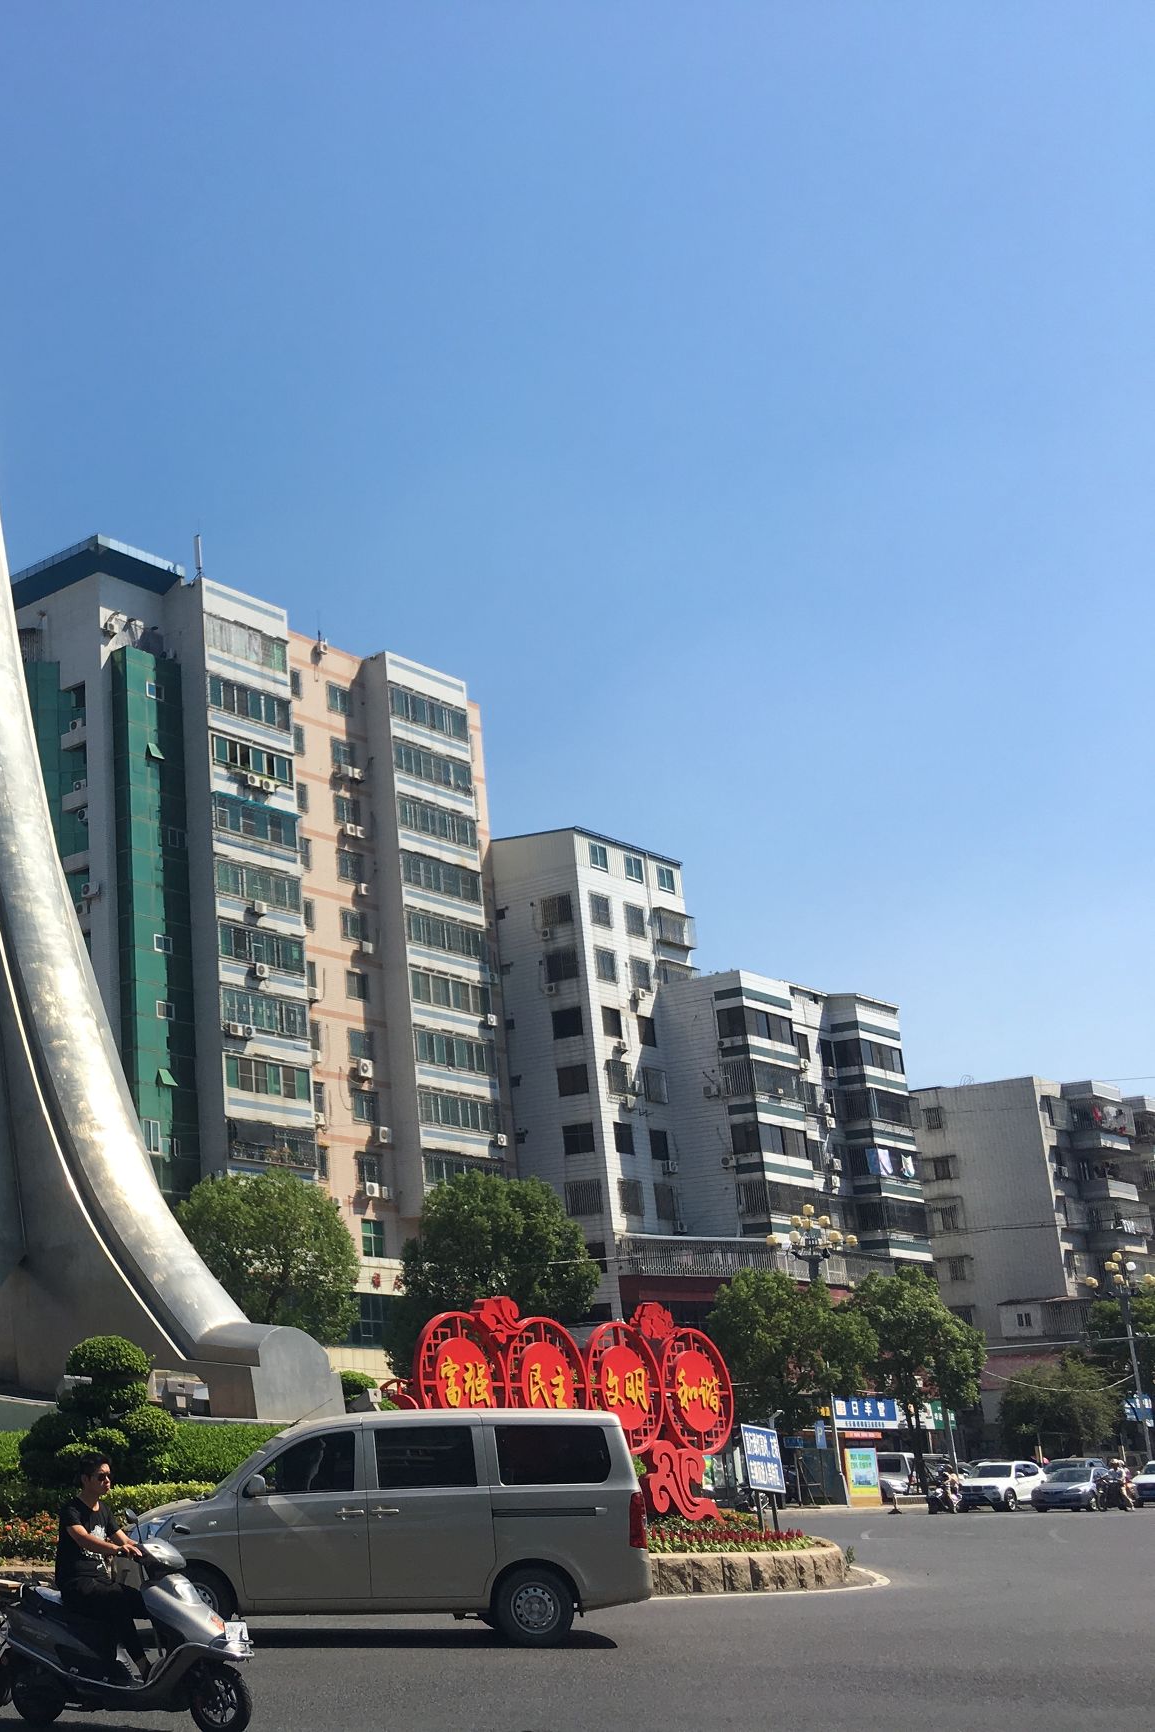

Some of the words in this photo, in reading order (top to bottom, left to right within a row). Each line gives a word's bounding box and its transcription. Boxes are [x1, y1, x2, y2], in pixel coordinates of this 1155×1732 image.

[440, 1355, 491, 1408] 富强
[528, 1362, 568, 1408] 民主
[605, 1366, 649, 1413] 文明
[676, 1367, 720, 1413] 和谐
